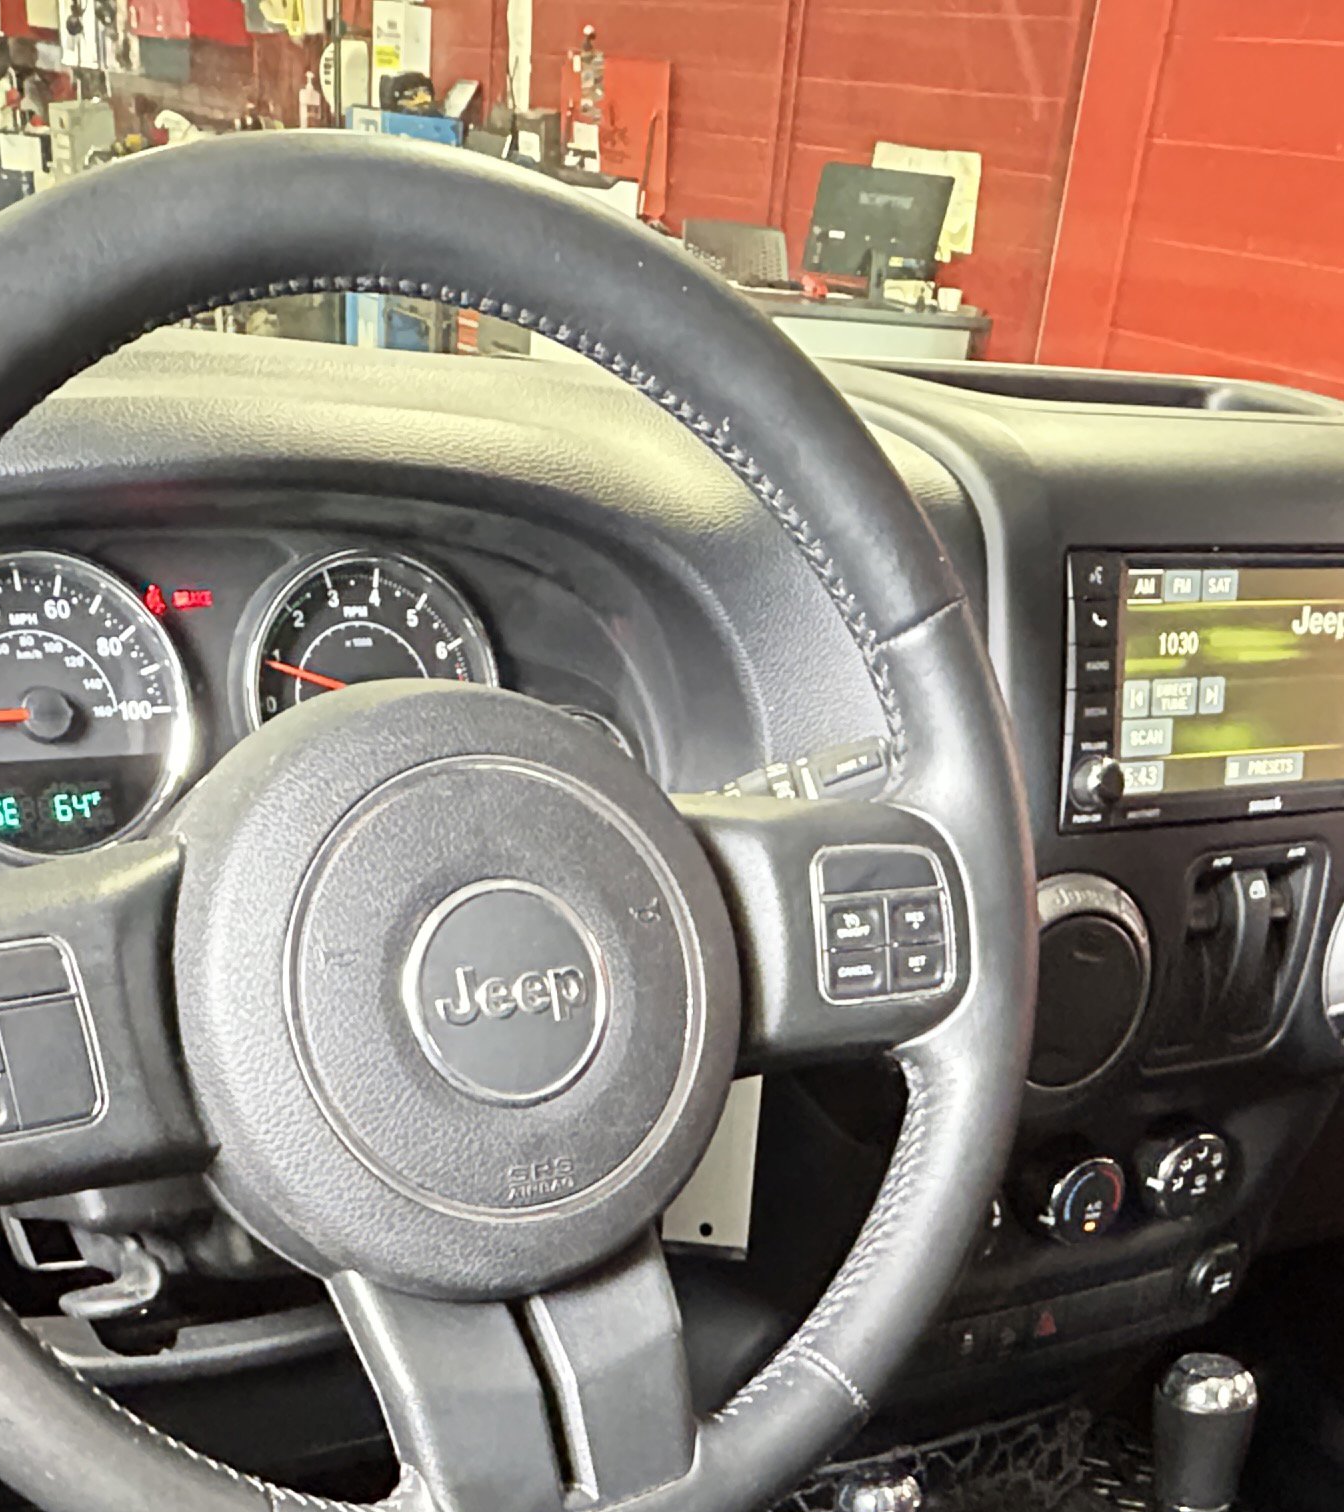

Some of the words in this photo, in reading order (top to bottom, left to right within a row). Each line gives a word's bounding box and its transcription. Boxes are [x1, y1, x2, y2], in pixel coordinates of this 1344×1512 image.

[1134, 578, 1156, 595] AM
[1172, 578, 1192, 594] FM
[1208, 577, 1232, 594] SAT
[327, 590, 340, 608] 3
[369, 589, 381, 607] 4
[44, 599, 71, 620] 60
[343, 605, 369, 618] RPM
[406, 609, 419, 627] 5
[9, 612, 38, 625] MPH
[292, 610, 305, 628] 2
[96, 637, 122, 657] 80
[435, 641, 448, 659] 6
[1158, 631, 1199, 656] 1030
[64, 655, 85, 668] 120
[83, 678, 103, 690] 140
[1156, 683, 1192, 698] DIRECT
[118, 701, 152, 720] 100
[266, 697, 277, 713] 0
[1161, 697, 1188, 710] TUNE
[1130, 729, 1164, 746] SCAN
[1247, 759, 1294, 776] PRESETS
[434, 963, 588, 1026] Jeep
[506, 1157, 575, 1181] SRS
[507, 1177, 575, 1202] AIRBAG
